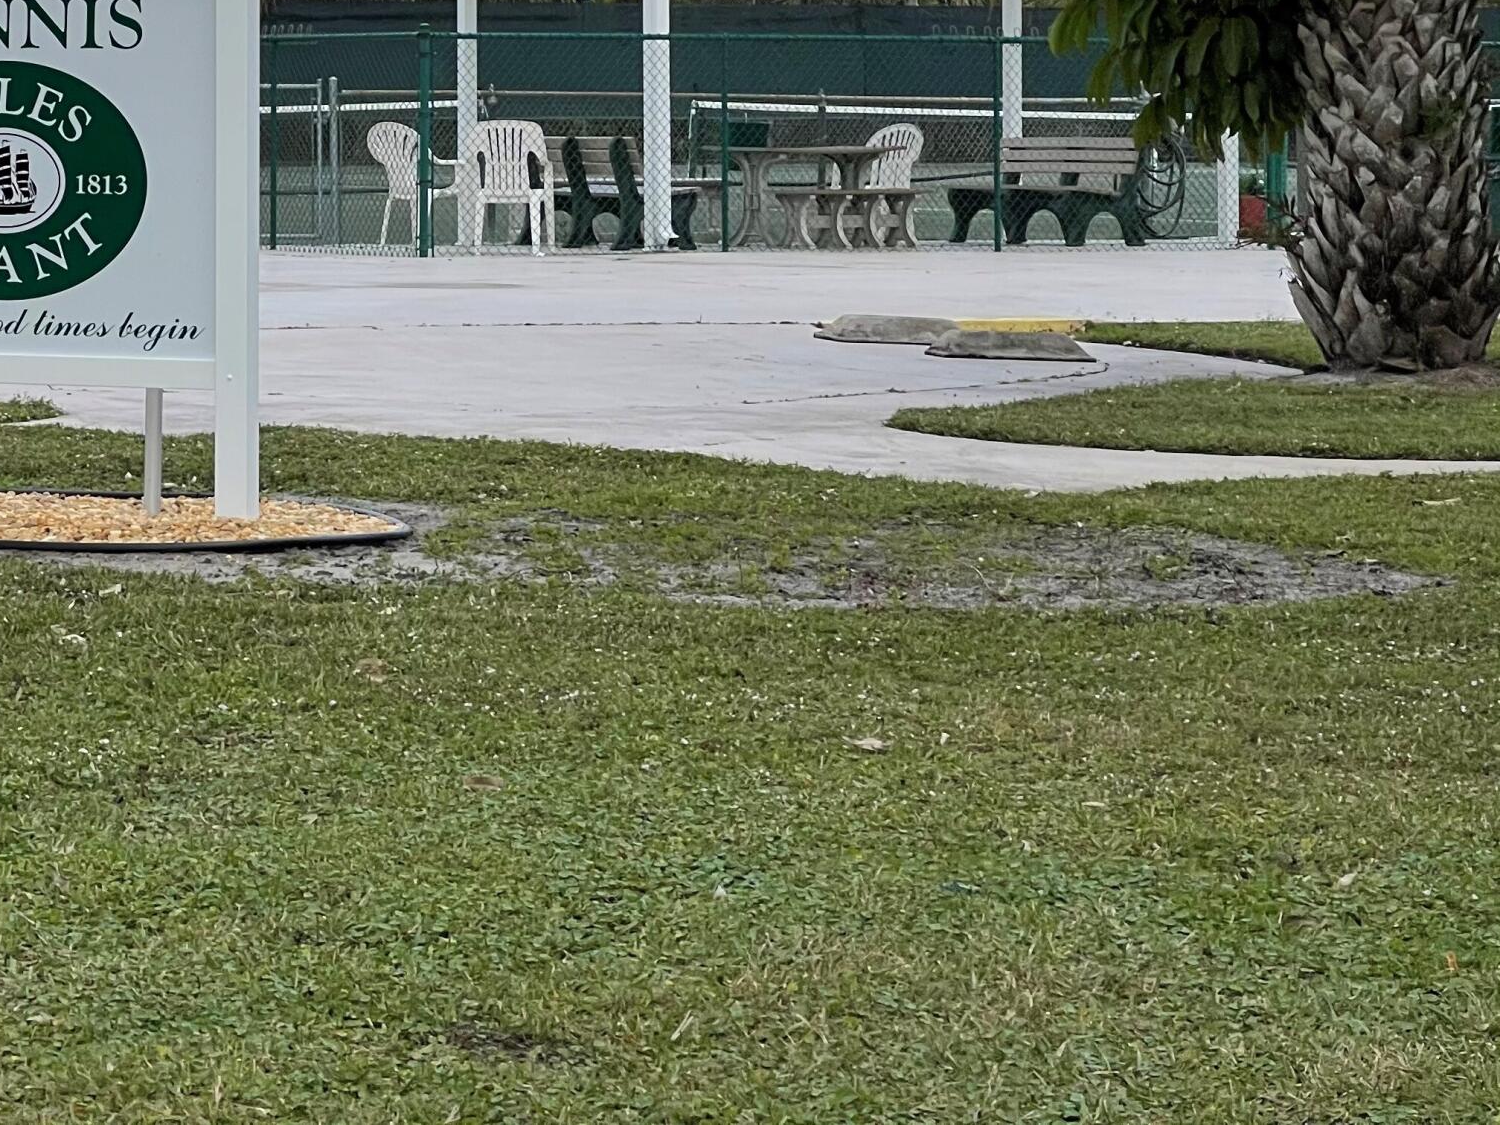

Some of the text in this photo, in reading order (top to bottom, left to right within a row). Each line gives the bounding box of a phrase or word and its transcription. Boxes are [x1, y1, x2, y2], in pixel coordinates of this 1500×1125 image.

[76, 175, 127, 194] 1813
[34, 310, 112, 338] times
[118, 312, 203, 351] begin
